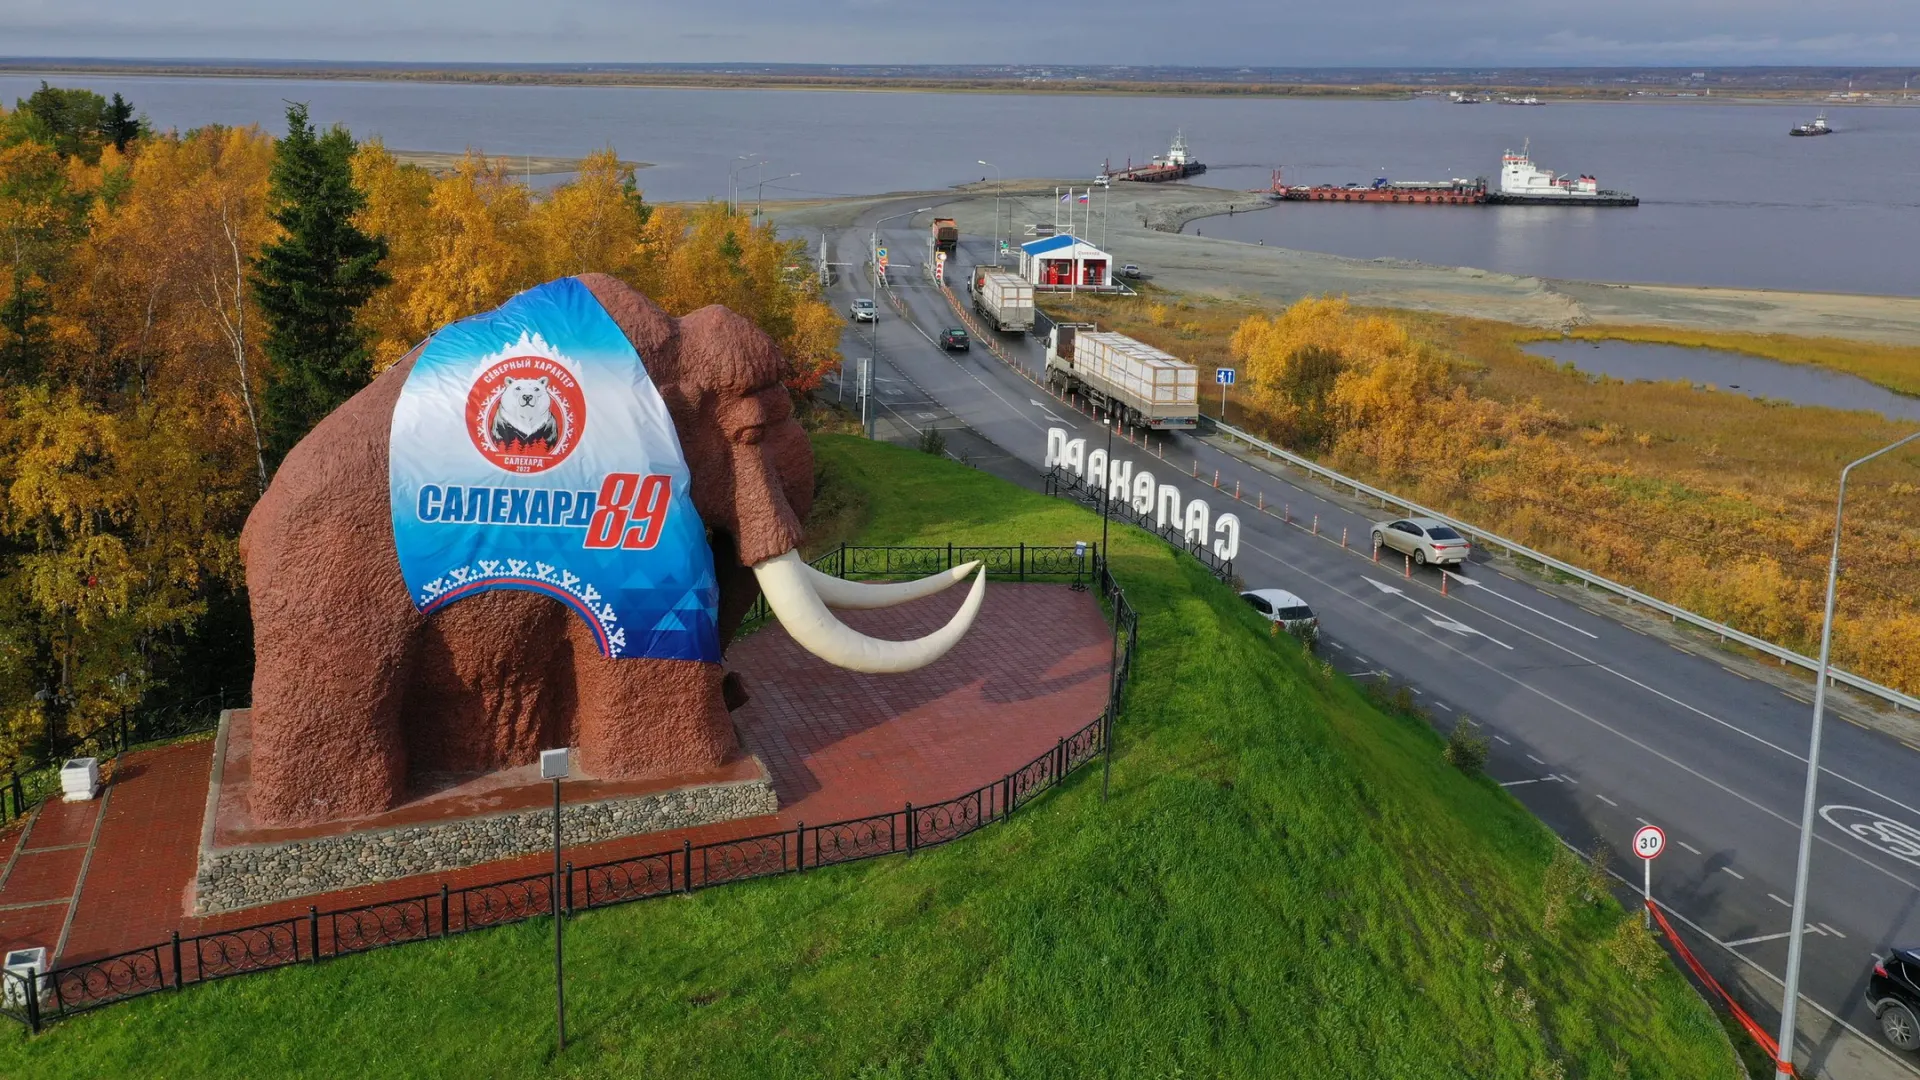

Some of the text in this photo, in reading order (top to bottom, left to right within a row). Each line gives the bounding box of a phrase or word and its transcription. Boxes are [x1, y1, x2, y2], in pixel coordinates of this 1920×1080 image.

[483, 359, 575, 389] СЕВЕРНЫЙ ХАРАКТЕР
[504, 457, 543, 468] САЛЕХАРД
[417, 473, 672, 550] САЛЕХАРД 89
[1640, 836, 1658, 850] 30
